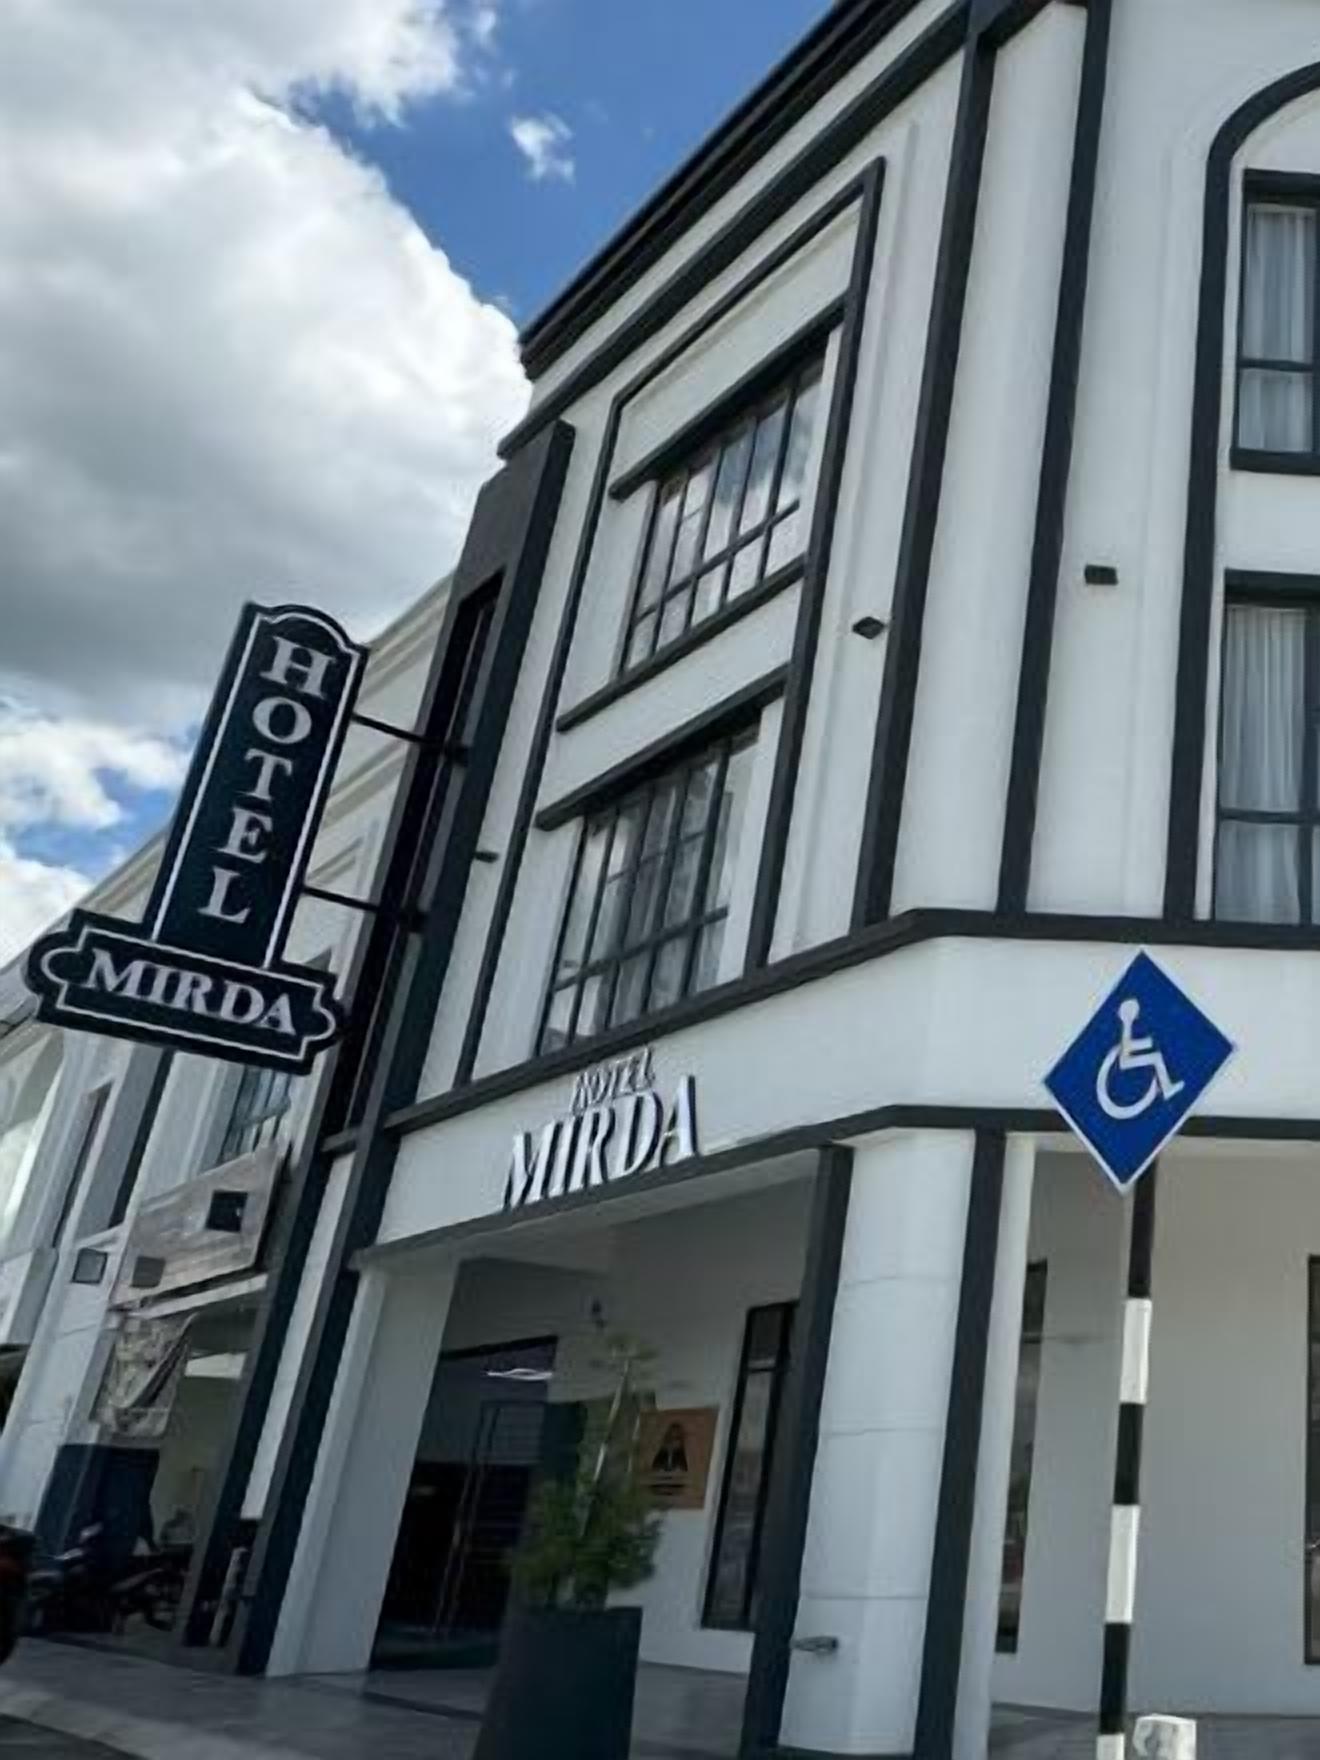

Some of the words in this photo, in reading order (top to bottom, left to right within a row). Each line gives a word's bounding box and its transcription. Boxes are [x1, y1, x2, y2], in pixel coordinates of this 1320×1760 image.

[197, 635, 337, 924] HOTEL
[84, 948, 297, 1035] MIRDA
[500, 1074, 700, 1211] MIRDA
